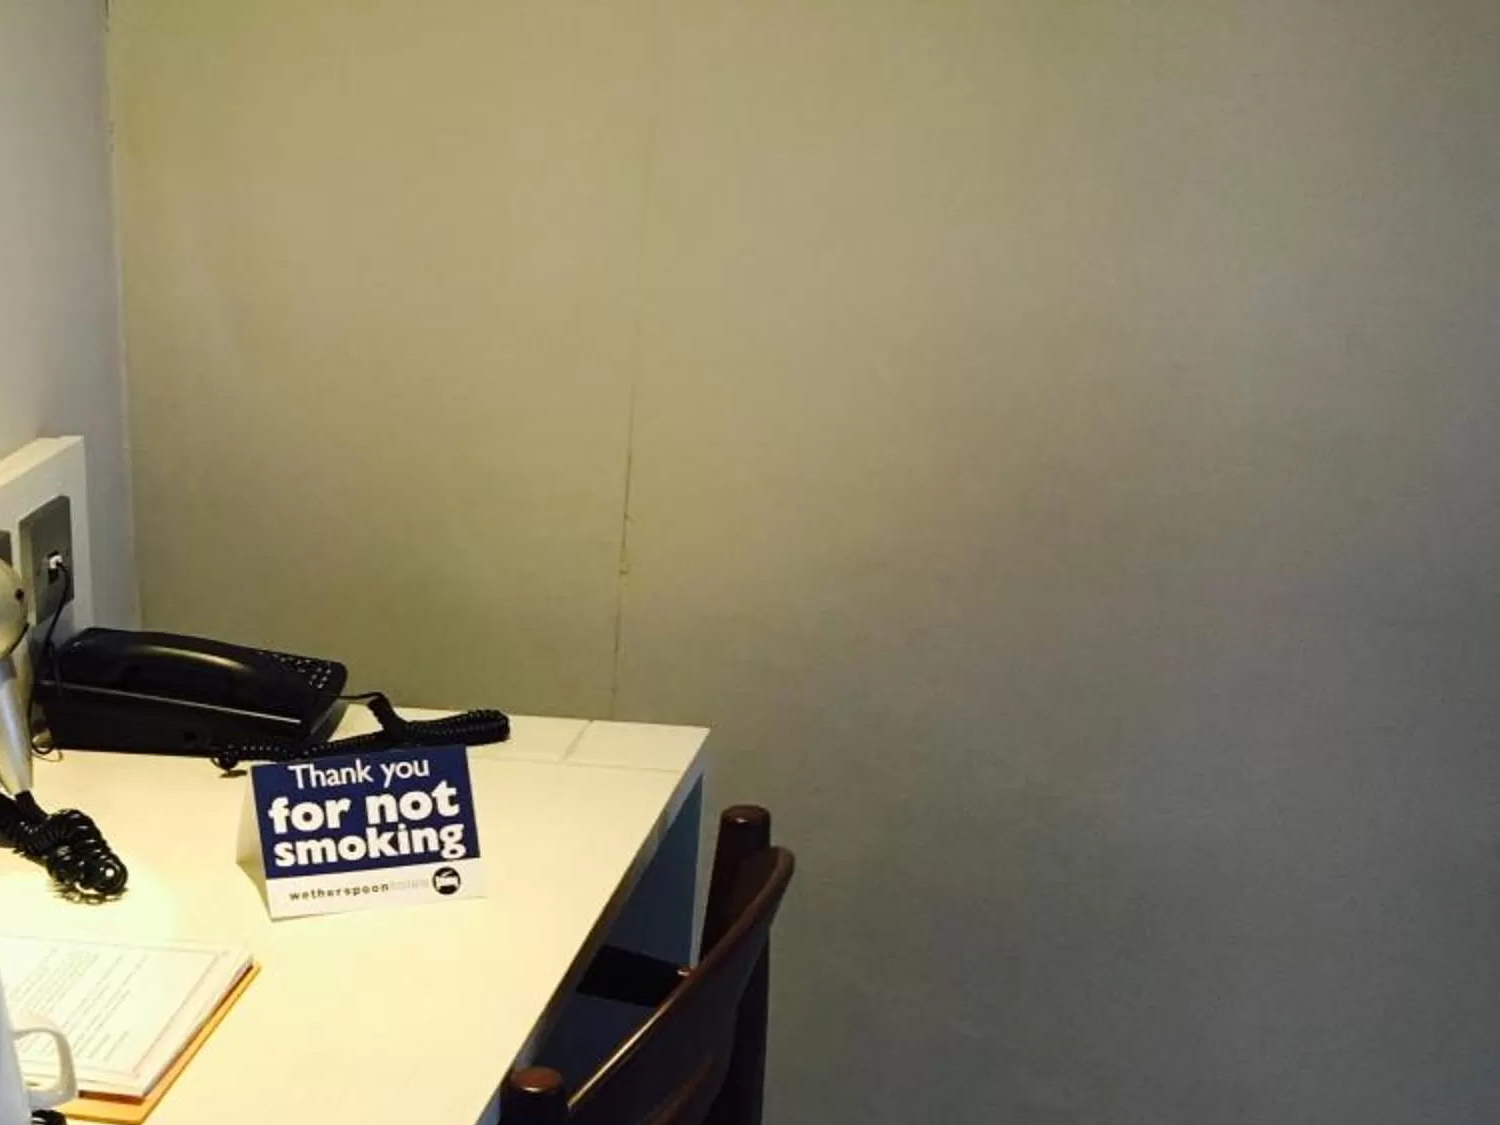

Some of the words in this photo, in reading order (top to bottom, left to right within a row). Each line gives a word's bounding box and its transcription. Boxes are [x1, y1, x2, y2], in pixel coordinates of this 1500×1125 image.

[288, 758, 374, 789] Thank
[380, 759, 430, 788] you
[268, 796, 352, 834] for
[365, 780, 461, 825] not
[273, 823, 467, 868] smoking
